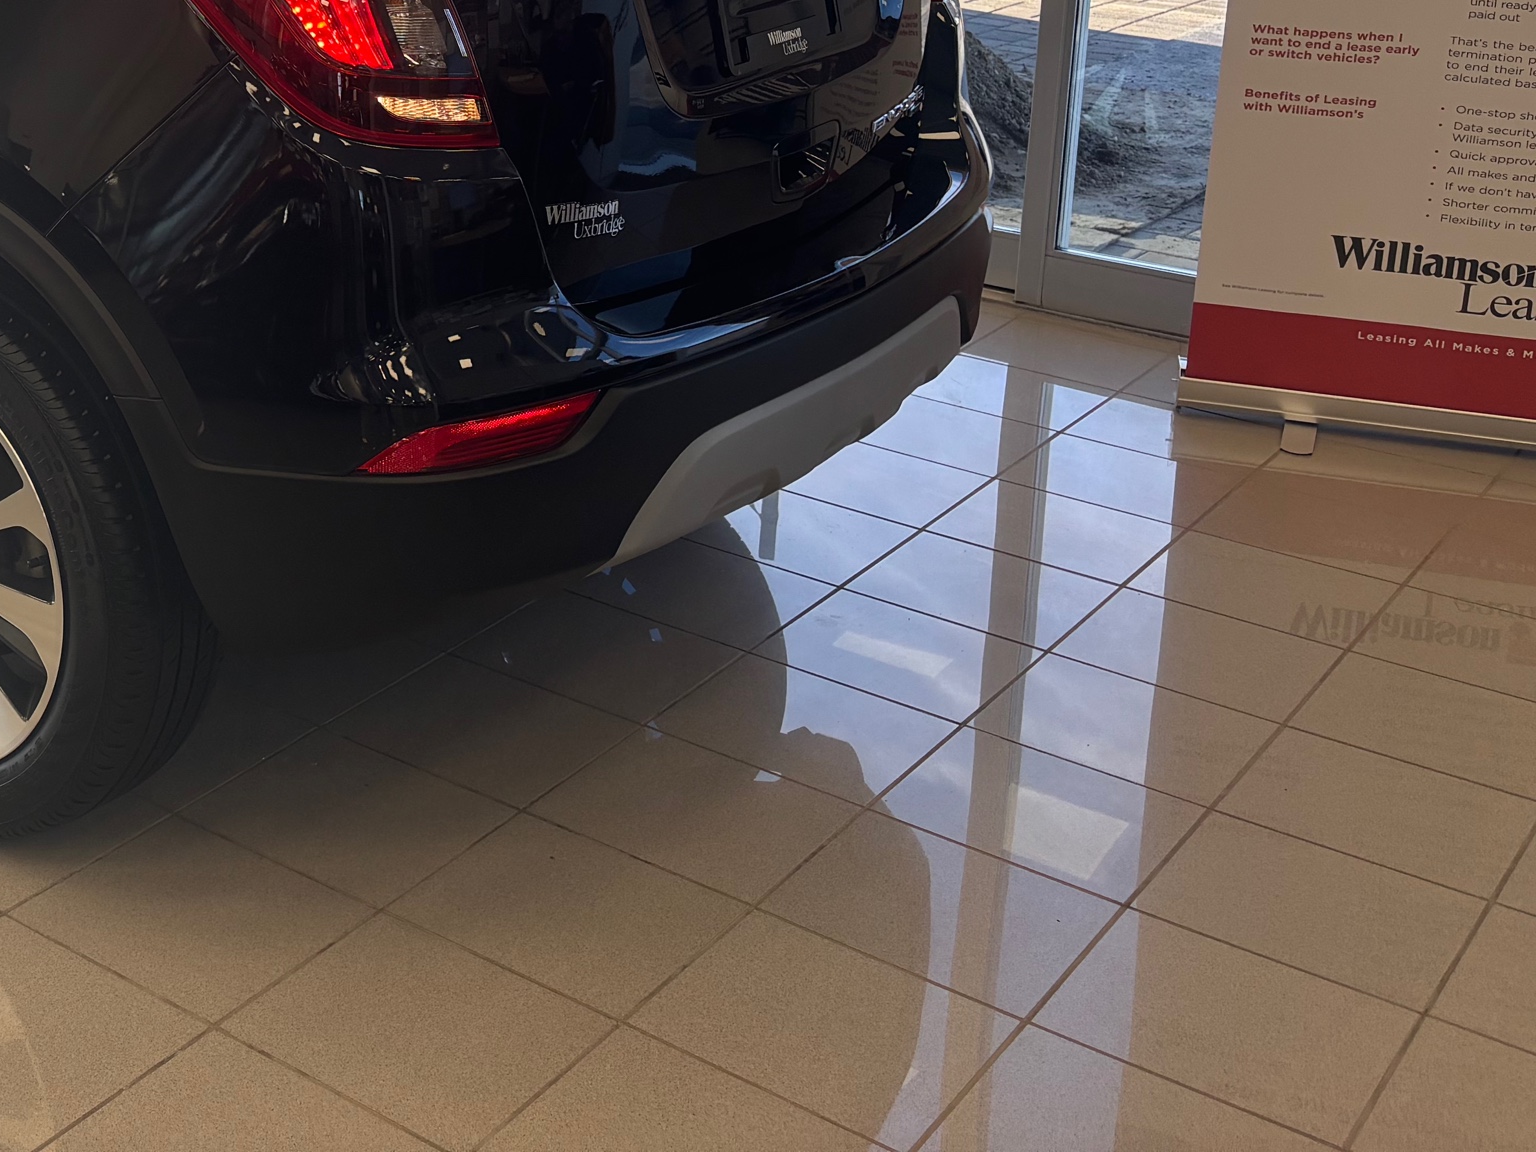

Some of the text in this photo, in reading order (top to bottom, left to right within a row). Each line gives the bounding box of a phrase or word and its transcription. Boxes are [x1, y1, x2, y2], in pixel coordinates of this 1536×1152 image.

[1501, 1, 1536, 13] ready
[1468, 10, 1520, 22] paid out
[767, 27, 802, 46] Williamson
[1252, 23, 1403, 43] What happens when I
[1250, 36, 1420, 57] want to end a lease early
[1450, 36, 1536, 52] That's the be
[1249, 48, 1380, 65] or switch vehicles?
[1448, 49, 1523, 63] termination
[1446, 60, 1459, 69] to
[1464, 63, 1489, 72] end
[1494, 65, 1524, 75] their
[1444, 73, 1510, 87] calculated
[1244, 88, 1377, 109] Benefits of Leasing
[1243, 101, 1364, 119] with Williamson's
[1456, 105, 1516, 120] One-stop
[1453, 121, 1536, 139] Data security
[1452, 133, 1522, 148] Williamson
[1449, 149, 1486, 162] Quick
[1447, 166, 1536, 183] All makes and
[1445, 182, 1453, 190] If
[1457, 185, 1475, 193] we
[1479, 186, 1512, 197] don't
[545, 200, 619, 225] Williamson
[1442, 197, 1490, 211] Shorter
[574, 214, 625, 239] Uxbridge
[1440, 213, 1500, 230] Flexibility
[1504, 221, 1515, 230] in
[1455, 281, 1536, 321] Lea
[1357, 331, 1417, 347] Leasing
[1424, 338, 1445, 349] All
[1452, 342, 1499, 355] Makes
[1506, 349, 1515, 357] &
